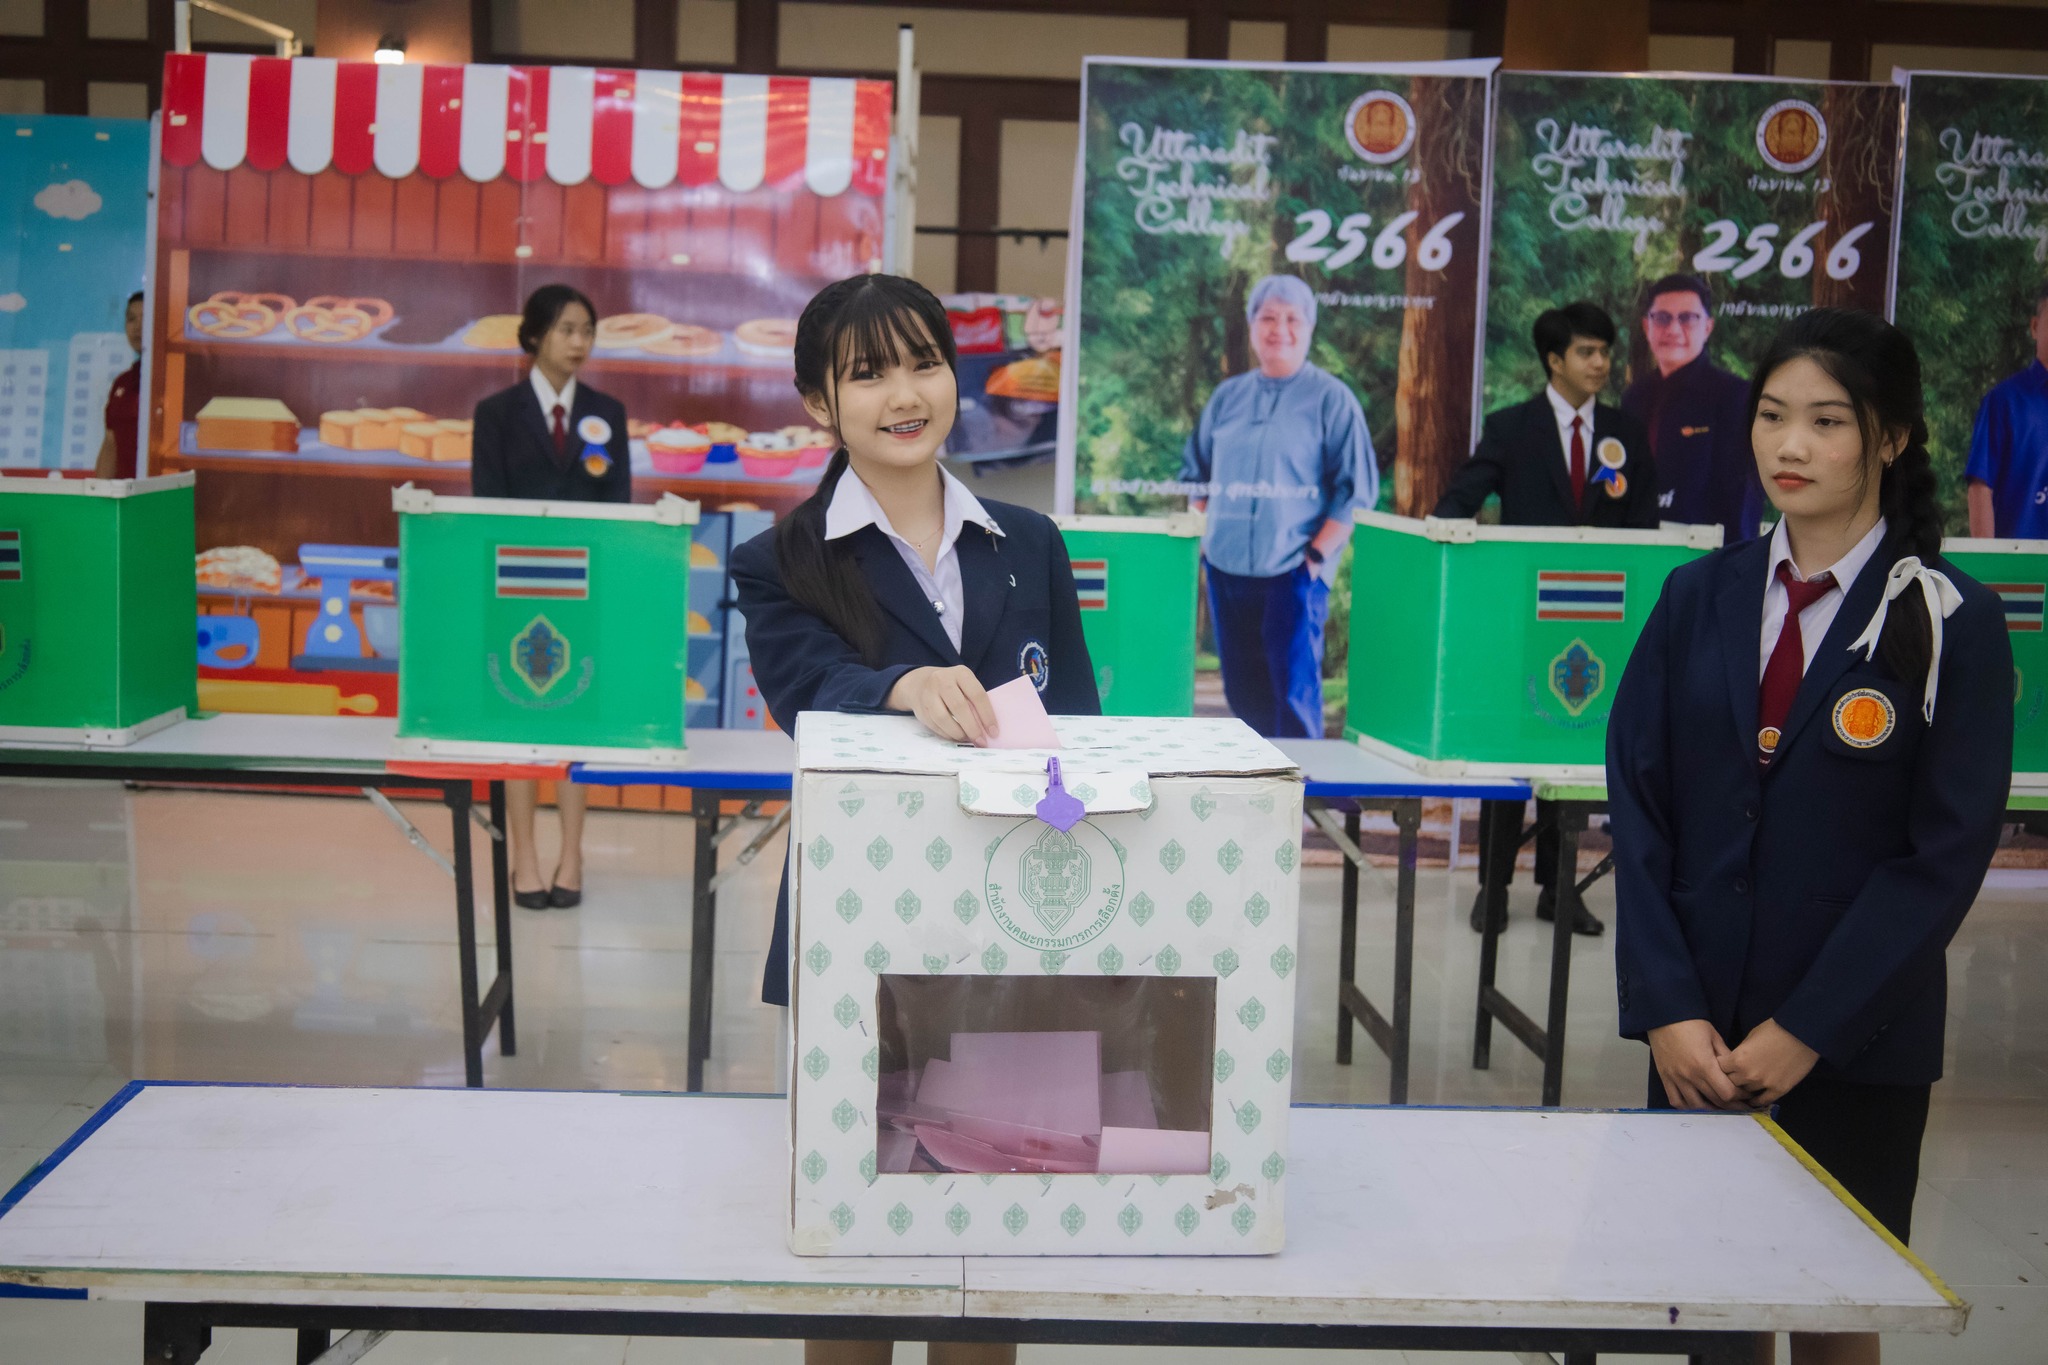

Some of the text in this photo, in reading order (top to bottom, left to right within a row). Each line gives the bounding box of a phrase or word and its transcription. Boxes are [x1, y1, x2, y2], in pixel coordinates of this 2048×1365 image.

[1118, 121, 1277, 164] Uttaradit
[1534, 117, 1692, 161] Uttaradit
[1938, 127, 2048, 167] Uttara
[1116, 157, 1271, 200] Technical
[1532, 152, 1687, 197] Technical
[1134, 197, 1250, 259] College
[1285, 209, 1465, 271] 2566
[1548, 194, 1666, 256] College
[1692, 218, 1875, 281] 2566
[1951, 199, 2048, 263] Colleg
[987, 881, 1122, 949] สำนักงานคณะกรรมการการเลือกตั้ง
